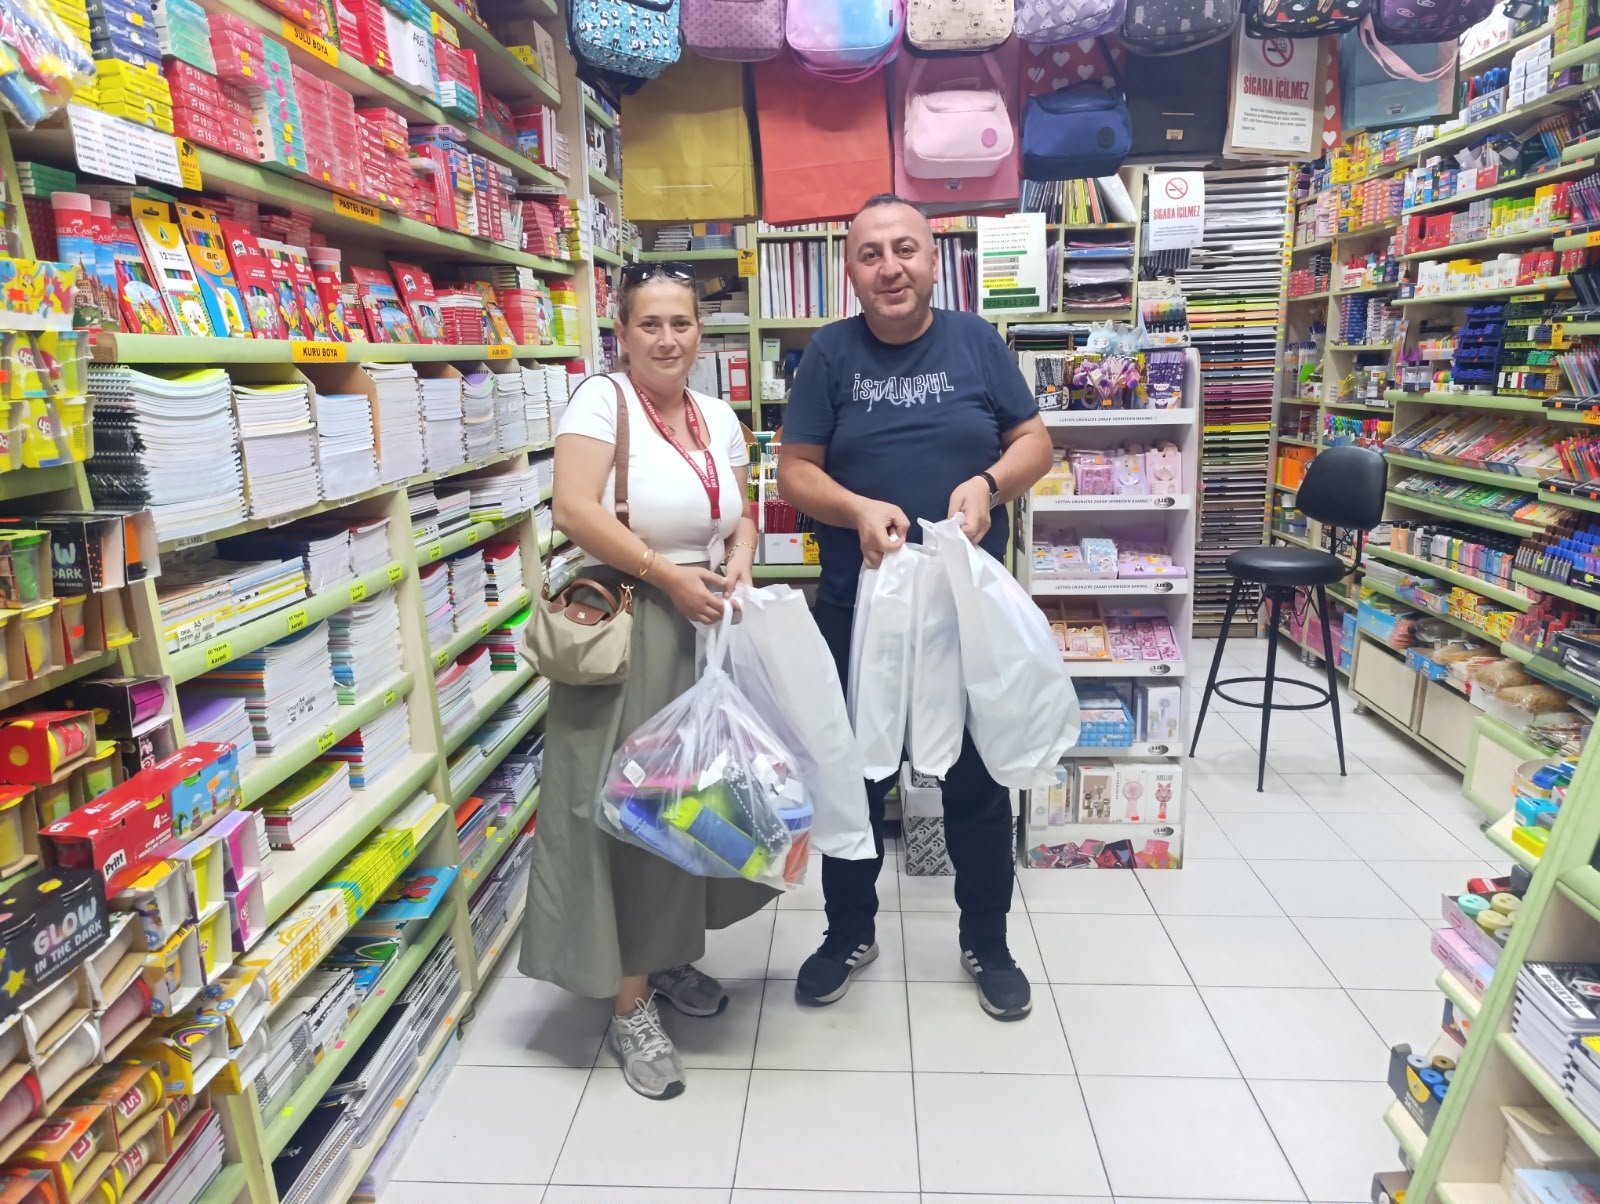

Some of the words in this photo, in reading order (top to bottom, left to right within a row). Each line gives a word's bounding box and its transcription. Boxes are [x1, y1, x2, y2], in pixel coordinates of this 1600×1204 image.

[293, 28, 312, 45] SULU
[312, 39, 329, 57] BOYA
[1243, 73, 1274, 97] SİGARA
[1275, 76, 1310, 101] İÇİLMEZ
[339, 199, 360, 213] PASTEL
[360, 205, 375, 217] BOYA
[1152, 207, 1176, 220] SİGARA
[1176, 205, 1201, 219] İÇİLMEZ
[303, 347, 320, 357] KURU
[322, 348, 338, 357] BOYA
[852, 372, 955, 402] İSTANBUL
[153, 814, 161, 829] 4
[105, 852, 123, 876] Pritt
[34, 896, 97, 956] GLOW
[34, 958, 47, 975] IN
[50, 940, 72, 962] THE
[74, 919, 102, 946] DARK
